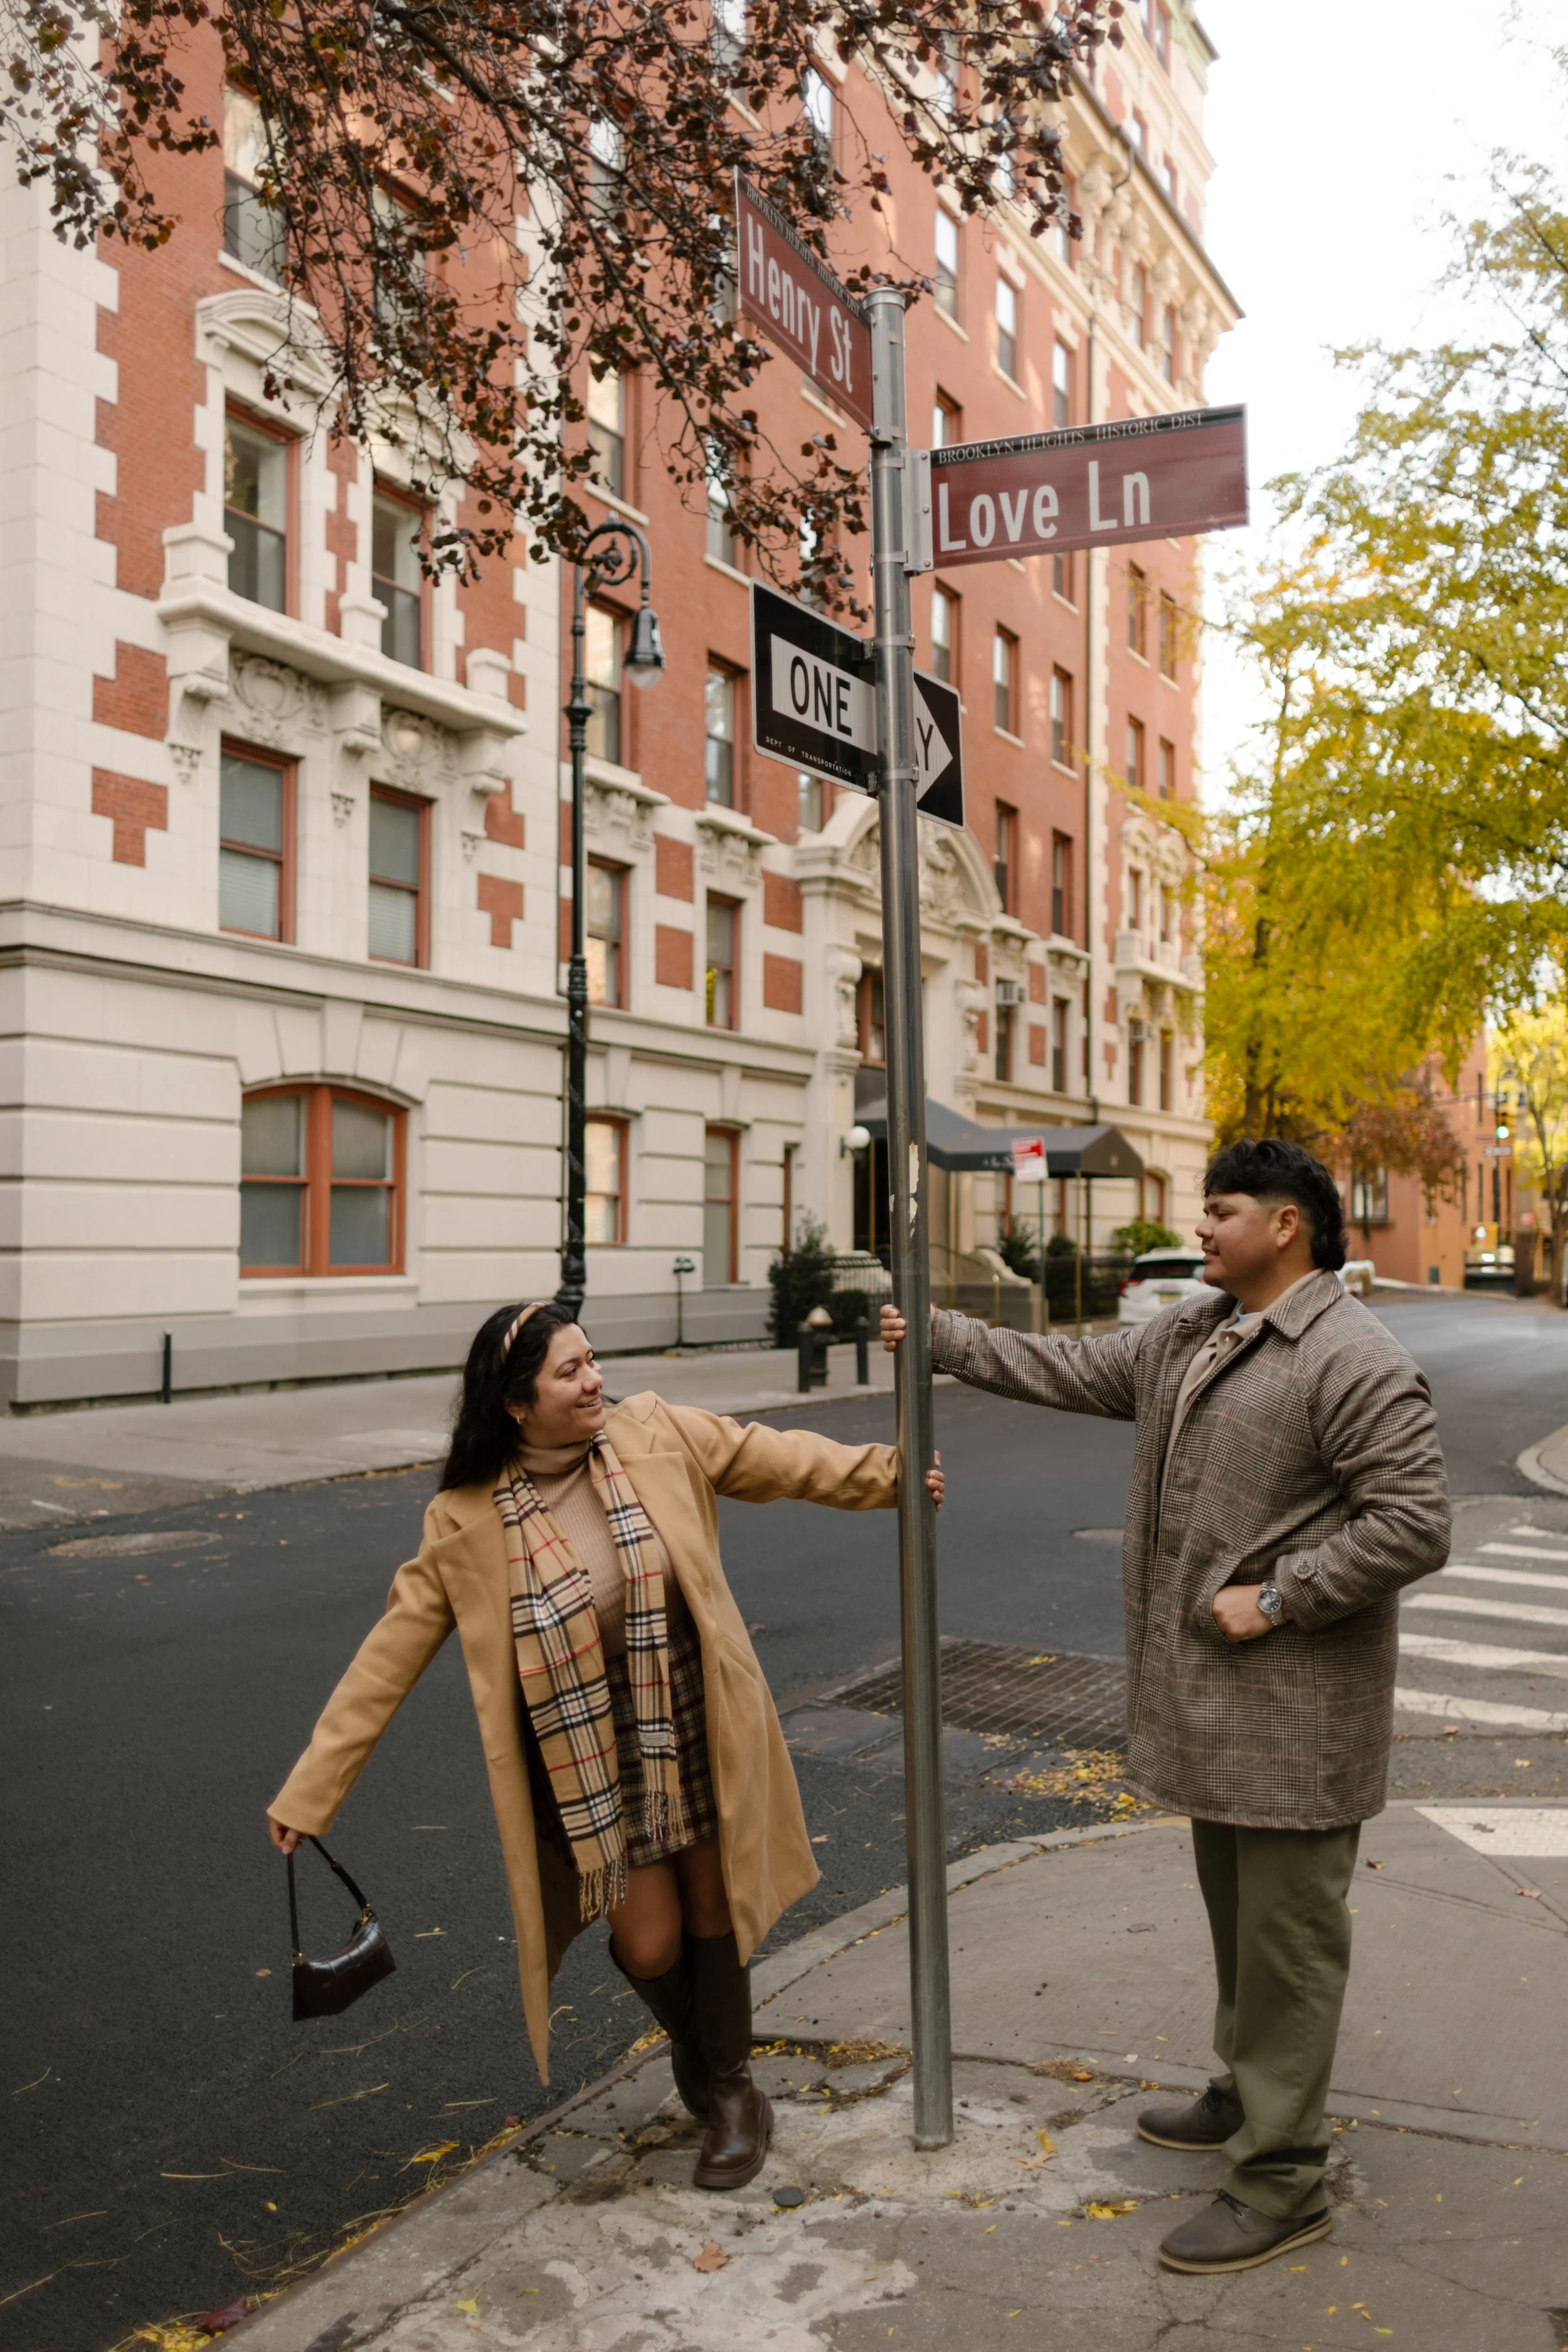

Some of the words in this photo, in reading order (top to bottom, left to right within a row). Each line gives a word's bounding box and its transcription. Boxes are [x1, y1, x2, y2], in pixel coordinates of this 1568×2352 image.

[746, 186, 784, 235] BROOKLYN
[785, 227, 815, 268] HEIGHTS
[817, 261, 847, 304] HISTORIC
[846, 300, 860, 317] DIST
[747, 212, 820, 376] Henry
[830, 304, 853, 393] St
[938, 440, 1015, 464] BROOKLYN
[1020, 429, 1085, 452] HEIGHTS
[1096, 418, 1165, 441] HISTORIC
[1171, 411, 1205, 429] DIST
[938, 482, 1059, 552] Love
[1088, 460, 1151, 531] Ln
[790, 655, 852, 737] ONE
[765, 736, 783, 748] DEPT
[788, 745, 796, 753] OF
[802, 751, 852, 777] TRANSPORTATION
